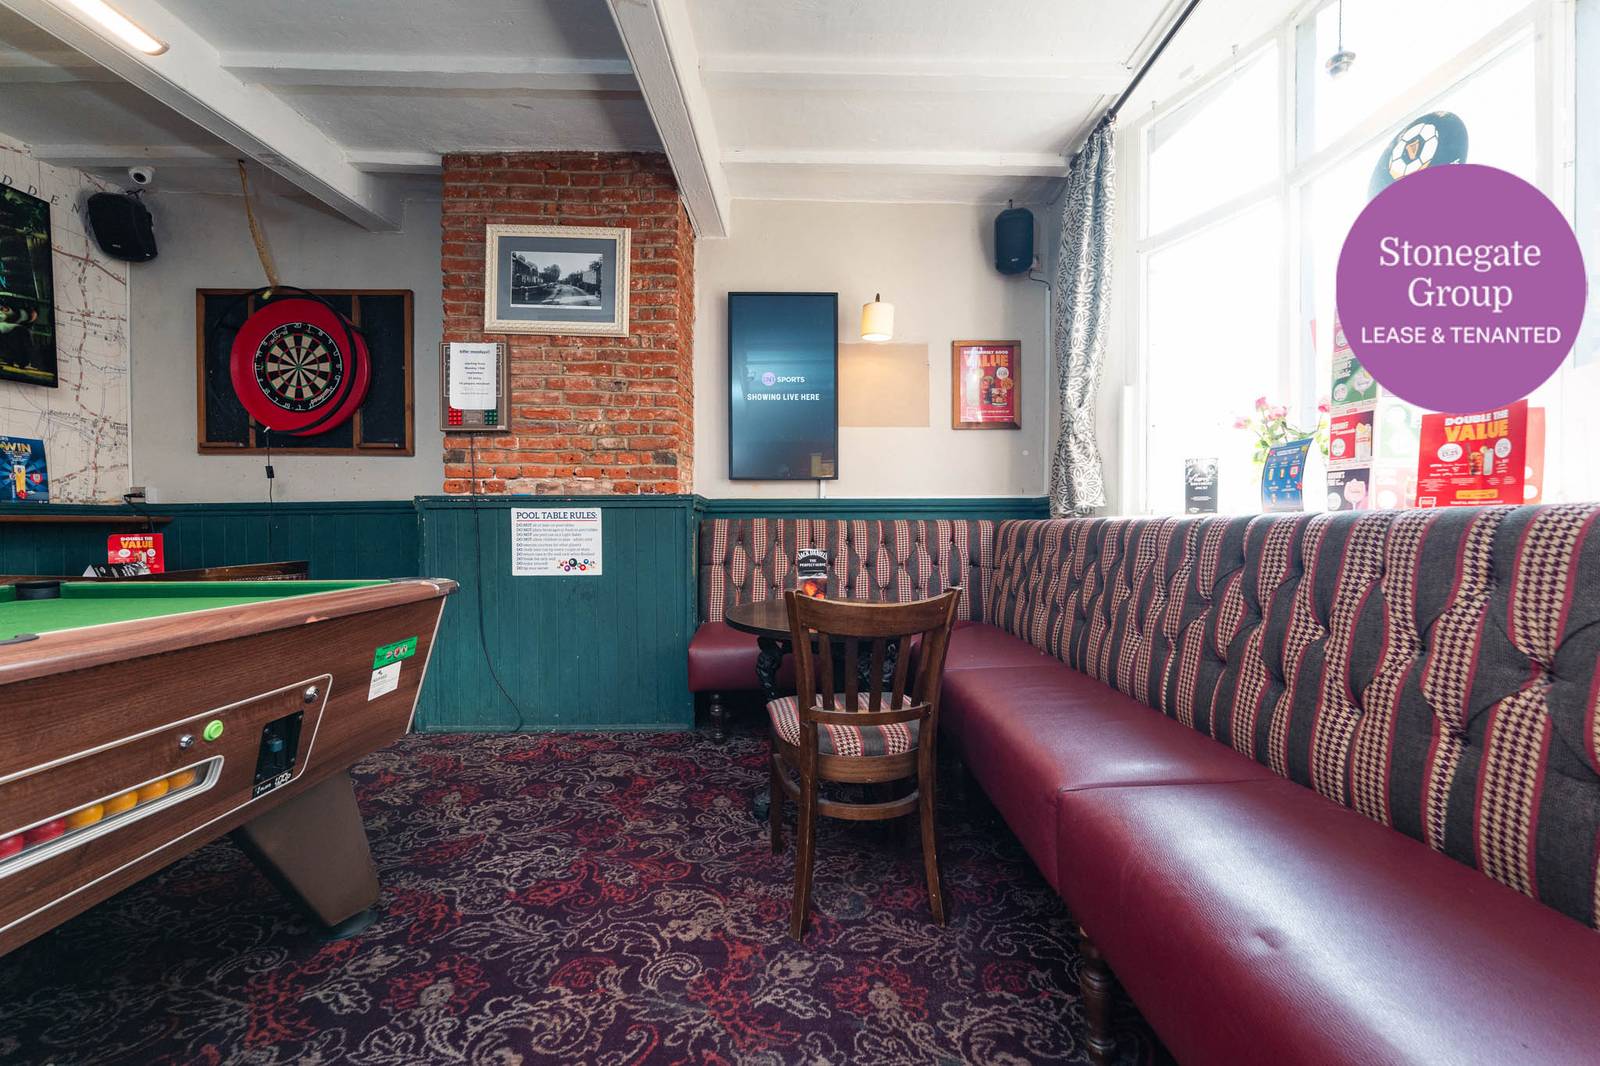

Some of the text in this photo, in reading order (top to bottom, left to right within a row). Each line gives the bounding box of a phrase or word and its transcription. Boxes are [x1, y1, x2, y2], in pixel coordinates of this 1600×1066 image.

[747, 393, 820, 401] SHOWING LIVE HERE
[1444, 413, 1492, 426] DOUBLE
[1444, 420, 1509, 442] VALUE
[4, 442, 32, 453] WIN
[516, 511, 598, 520] POOL TABLE RULES:
[121, 540, 153, 549] VALUE
